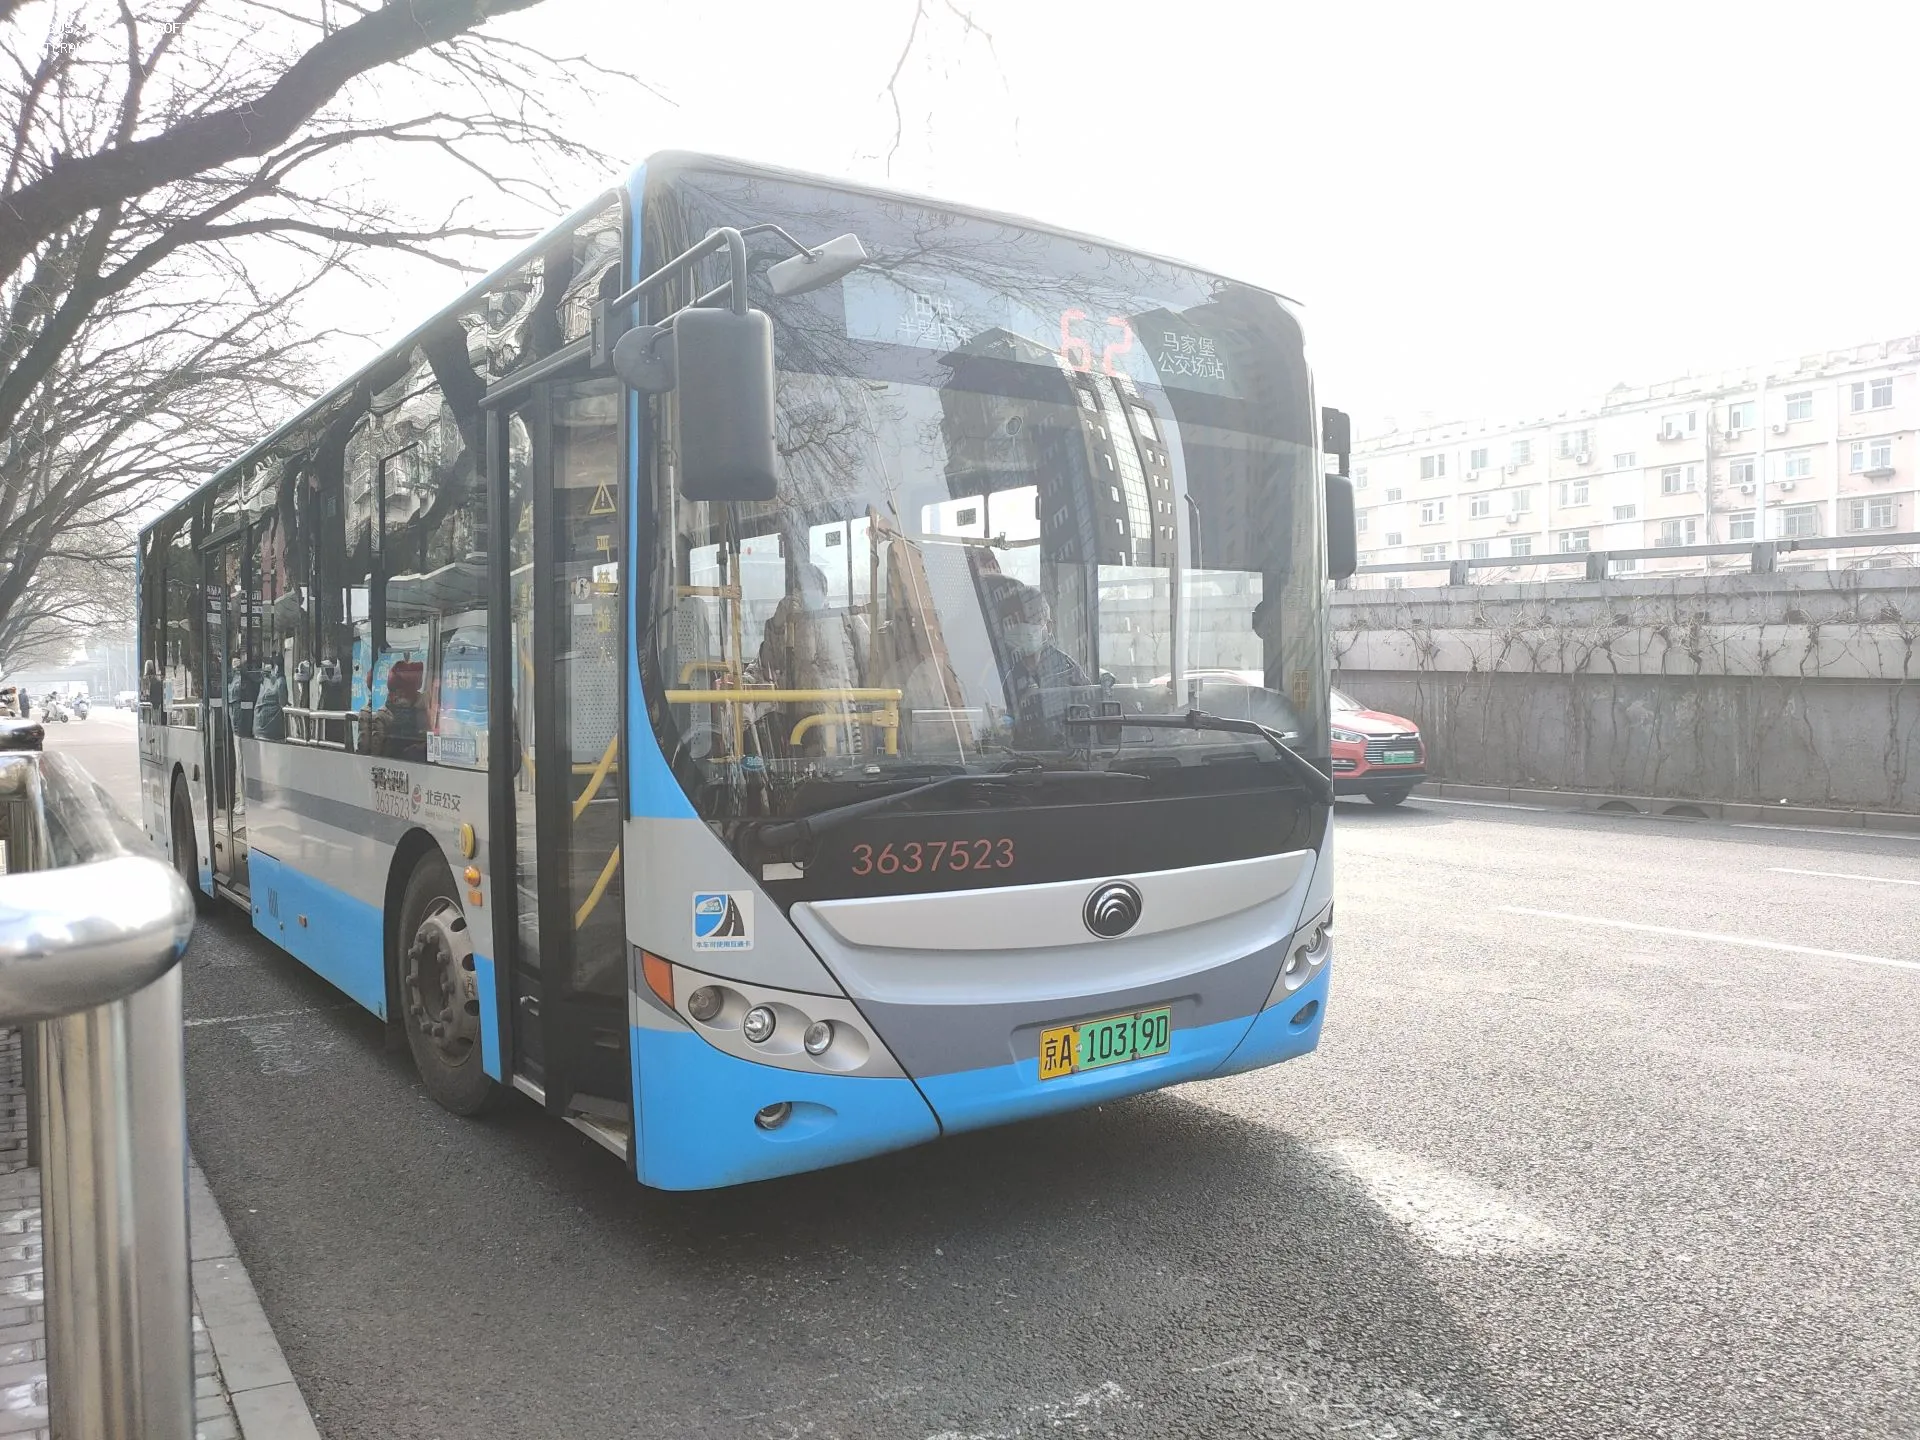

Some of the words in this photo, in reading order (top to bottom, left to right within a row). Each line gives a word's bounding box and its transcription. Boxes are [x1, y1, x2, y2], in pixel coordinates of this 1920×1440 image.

[1059, 308, 1133, 376] 62
[1163, 331, 1216, 357] 马家堡
[1158, 352, 1226, 380] 公交场站
[375, 790, 410, 820] 3637523
[425, 789, 461, 812] 北京公交
[851, 838, 1016, 876] 3637523
